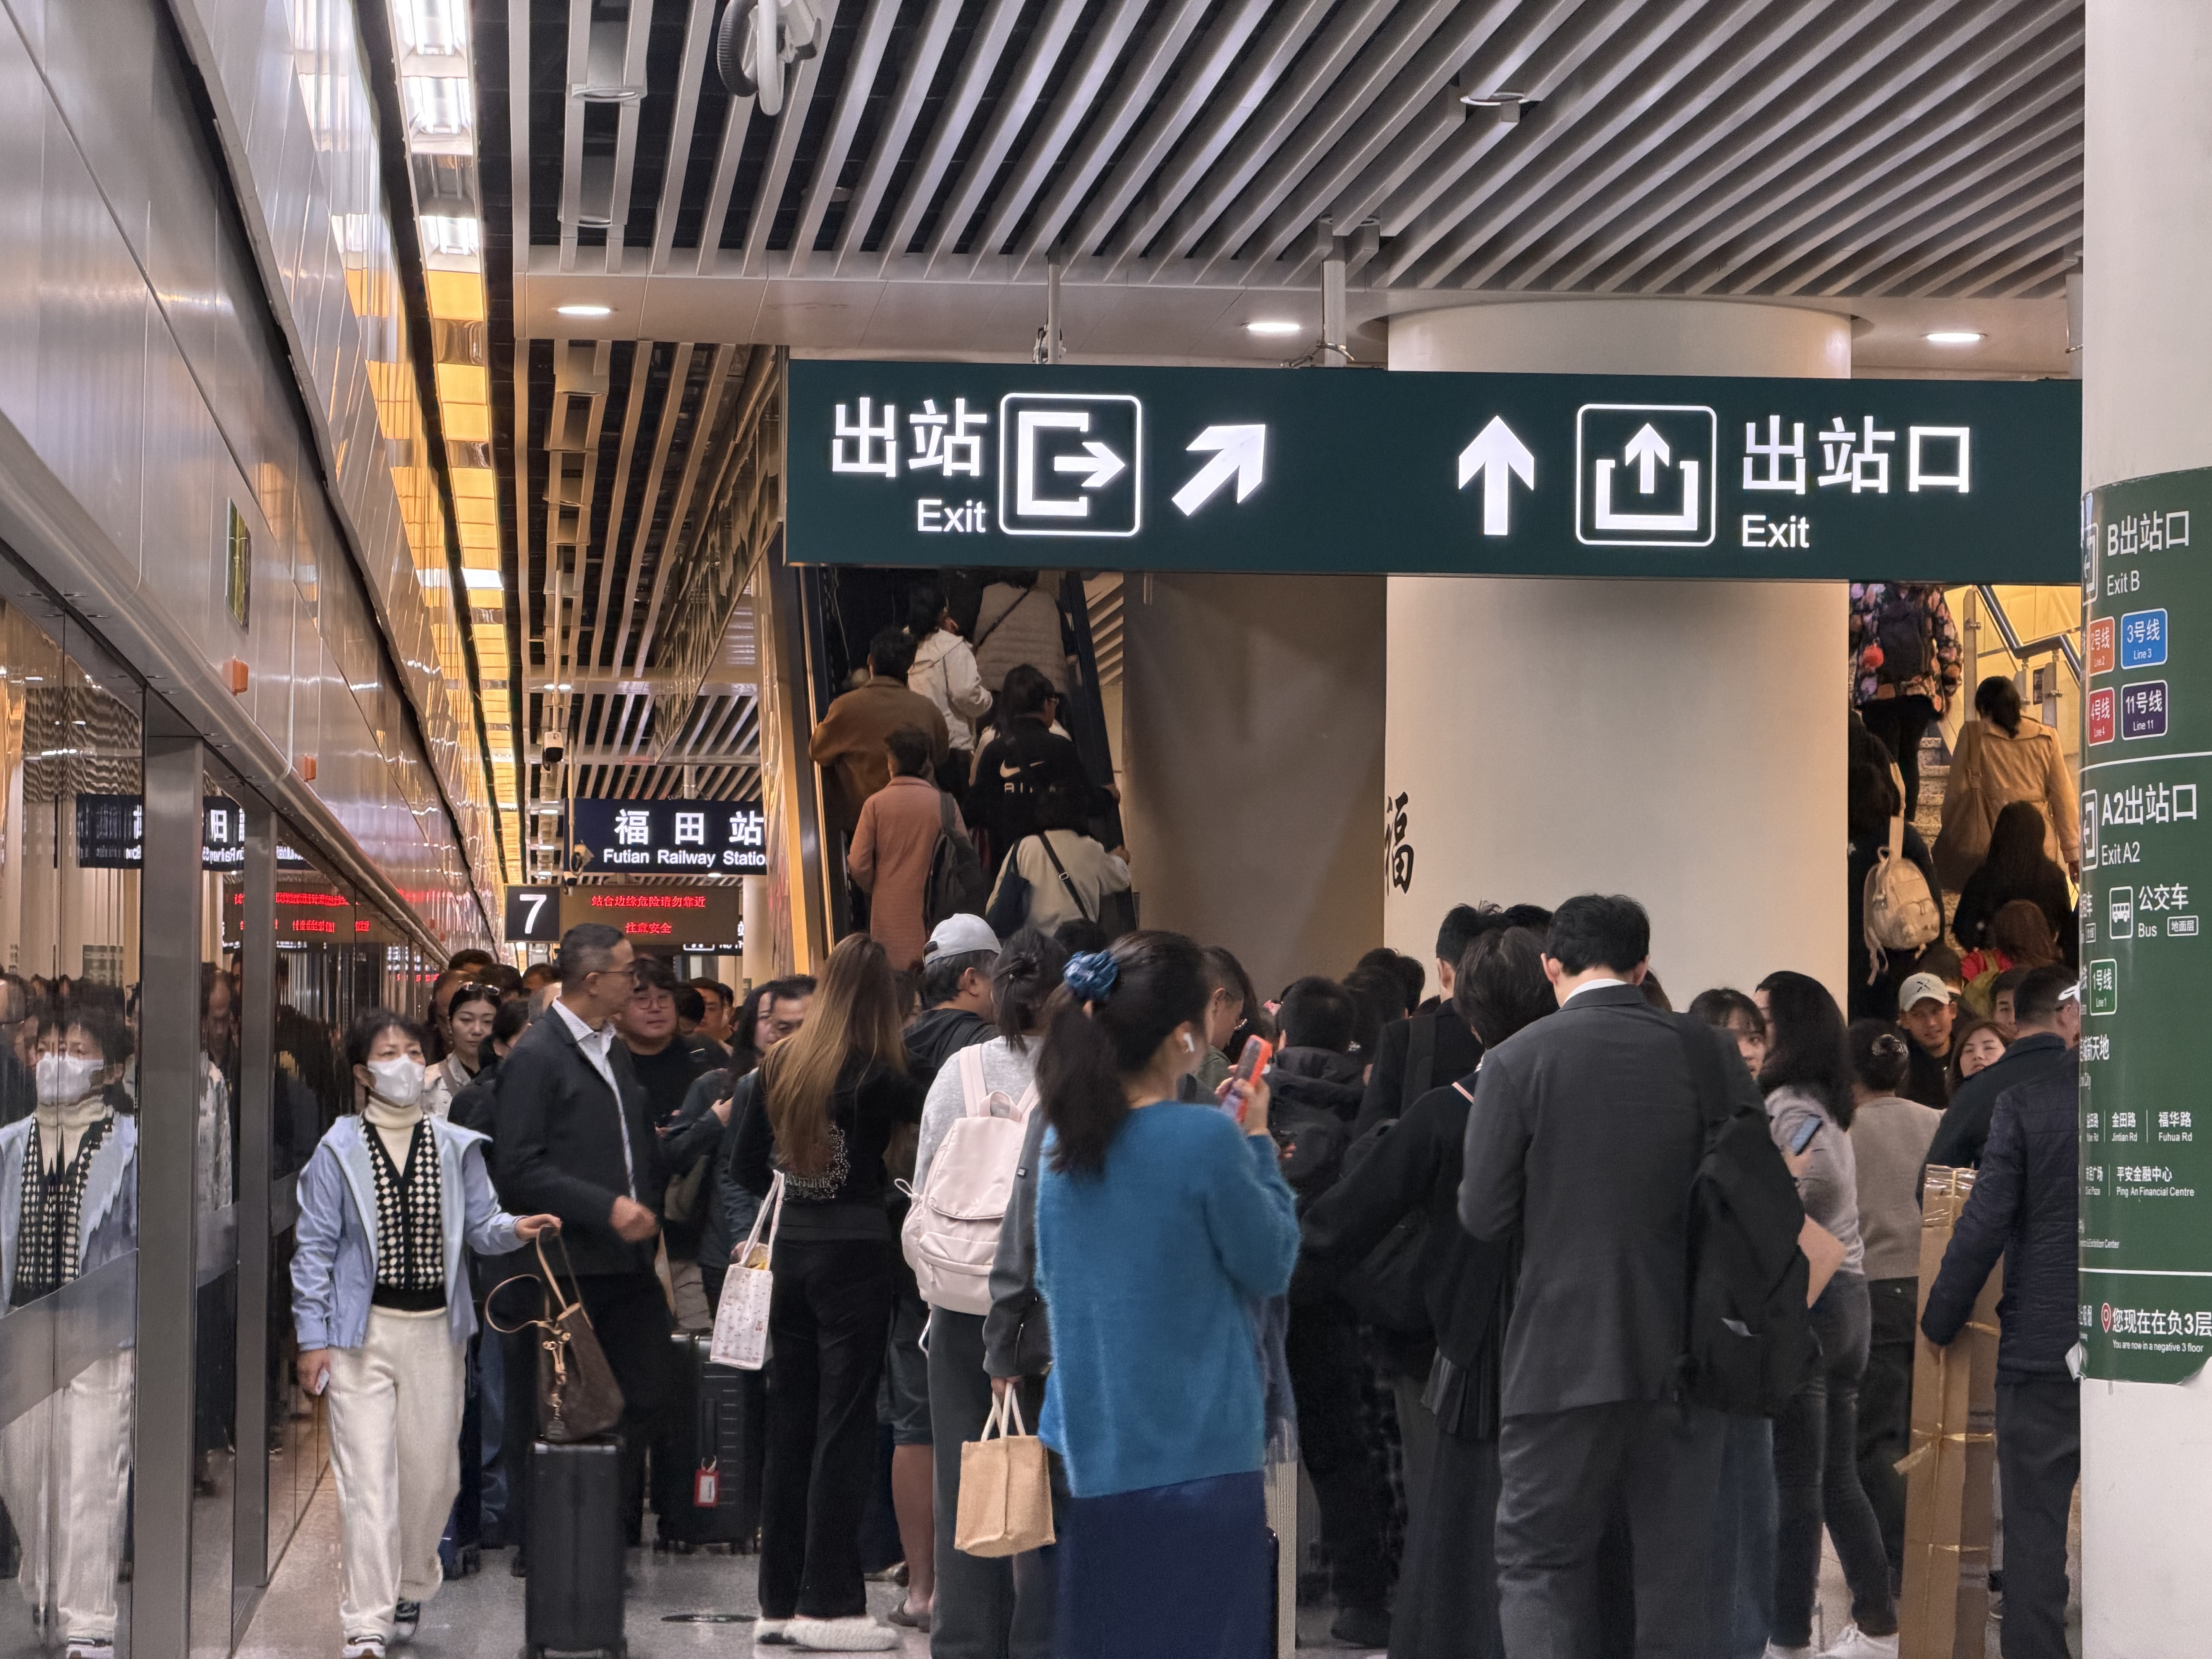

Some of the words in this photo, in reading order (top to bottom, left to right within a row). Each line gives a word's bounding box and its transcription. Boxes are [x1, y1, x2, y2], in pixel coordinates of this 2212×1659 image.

[833, 397, 987, 477] 出站
[1743, 415, 1970, 495] 出站口
[918, 499, 986, 532] Exit
[1743, 515, 1809, 548] Exit
[2108, 511, 2189, 556] B出站口
[2107, 573, 2128, 596] Exit
[2131, 570, 2140, 591] B
[2127, 618, 2160, 643] 3号线
[2133, 651, 2147, 659] Line
[2147, 648, 2152, 658] 3
[2126, 689, 2162, 714] 11号线
[2133, 721, 2145, 731] Line
[2147, 720, 2154, 729] 11
[2102, 782, 2197, 826] A2出站口
[614, 809, 764, 846] 福田站
[603, 848, 650, 863] Futian
[658, 849, 716, 867] Railway
[723, 850, 766, 866] Statio
[2102, 844, 2121, 866] Exit
[2123, 841, 2140, 863] A2
[592, 895, 706, 907] 站台边缘危险请勿靠近
[2139, 883, 2188, 911] 公交车
[520, 894, 546, 934] 7
[625, 922, 672, 934] 注意安全
[2138, 922, 2157, 938] Bus
[2171, 920, 2195, 932] 地面层
[2093, 968, 2112, 991] 1号线
[2112, 1112, 2136, 1128] 金田路
[2159, 1111, 2191, 1127] 福华路
[2129, 1132, 2137, 1142] Rd
[2159, 1132, 2180, 1141] Fuhua
[2182, 1132, 2192, 1141] Rd
[2117, 1166, 2172, 1182] 平安金融中心
[2116, 1186, 2129, 1198] Ping
[2130, 1187, 2138, 1196] An
[2139, 1187, 2168, 1196] Financial
[2170, 1187, 2195, 1196] Centre
[2112, 1308, 2212, 1336] 您现在在负3层
[2113, 1339, 2121, 1349] You
[2143, 1341, 2148, 1350] in
[2154, 1342, 2181, 1353] negative
[2182, 1342, 2186, 1352] 3
[2188, 1342, 2204, 1352] floor
